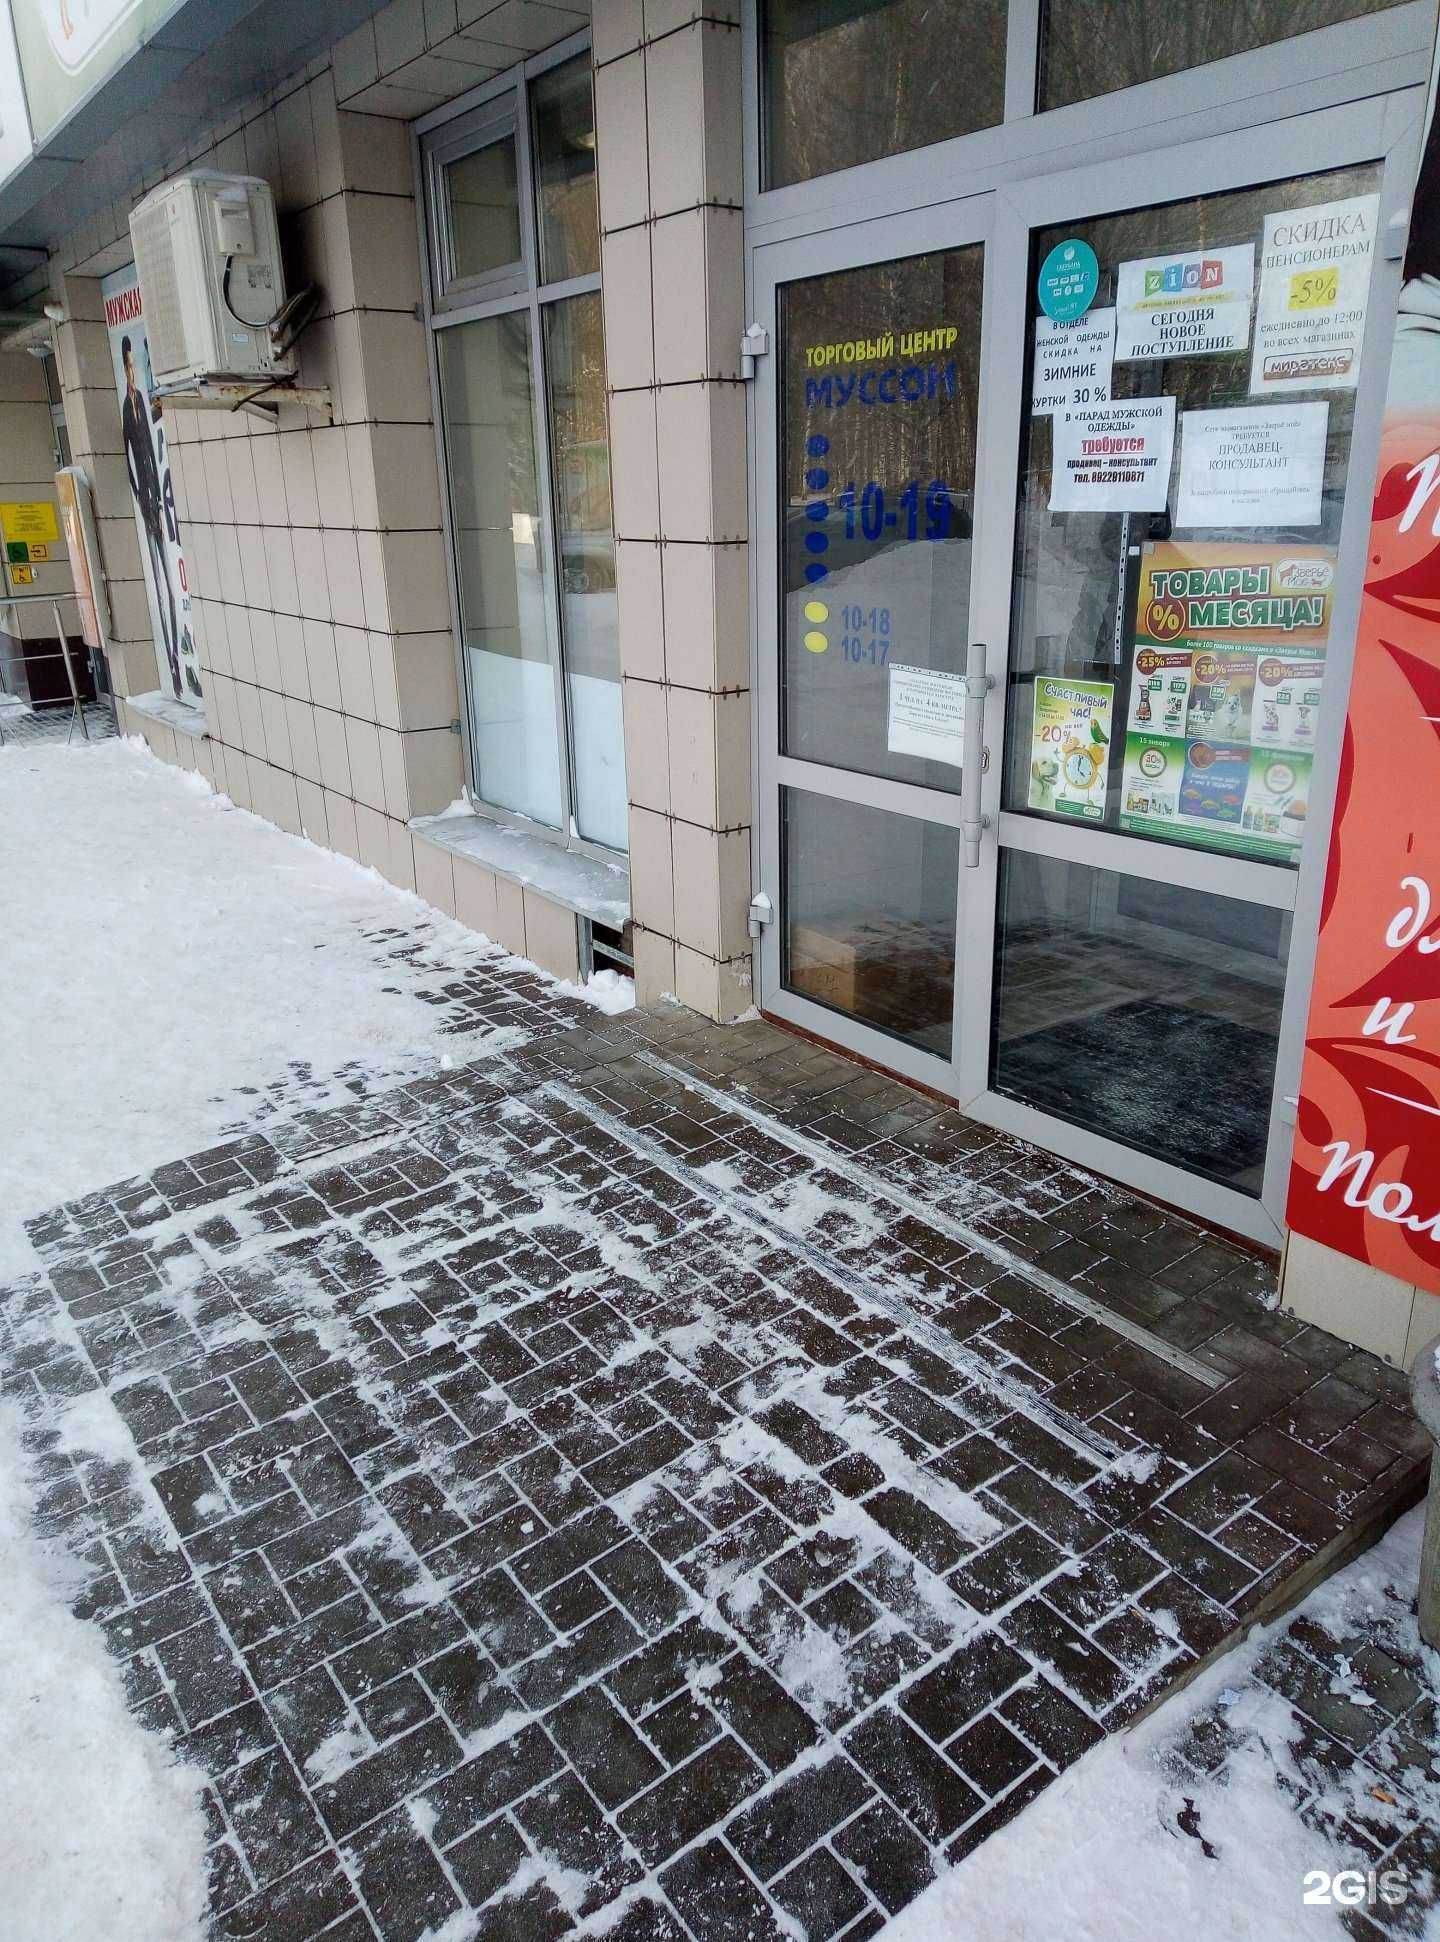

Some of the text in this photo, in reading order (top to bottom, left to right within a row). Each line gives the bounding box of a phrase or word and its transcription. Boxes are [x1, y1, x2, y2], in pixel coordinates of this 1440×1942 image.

[1273, 213, 1366, 247] СКИДКА
[1266, 240, 1371, 268] ПЕНСИОНЕРАМ
[1291, 274, 1336, 304] -5%
[1151, 307, 1215, 326] СЕГОДНЯ
[1317, 316, 1330, 329] до
[1333, 310, 1363, 324] 12:00
[1037, 331, 1110, 348] ЖЕНСКОЙ ОДЕЖДЫ
[1159, 323, 1206, 340] НОВОЕ
[805, 327, 958, 367] ТОРГОВЫЙ ЦЕНТР
[1043, 344, 1103, 359] СКИДКА НА
[1131, 335, 1234, 357] ПОСТУПЛЕНИЕ
[1044, 363, 1097, 382] ЗИМНИЕ
[805, 359, 958, 408] МУССОН
[1072, 388, 1090, 404] 30
[1094, 385, 1107, 402] %
[1065, 406, 1163, 422] В «ПАРАД МУЖСКОЙ
[1087, 421, 1136, 433] ОДЕЖДЫ»
[1219, 440, 1284, 456] ПРОДАВЕЦ-
[1208, 456, 1289, 471] КОНСУЛЬТАНТ
[1073, 473, 1090, 484] тел.
[839, 480, 952, 541] 10-19
[1151, 566, 1271, 599] ТОВАРЫ
[841, 606, 890, 636] 10-18
[1189, 597, 1325, 631] МЕСЯЦА!
[841, 635, 890, 666] 10-17
[1070, 706, 1092, 720] ЧАС!
